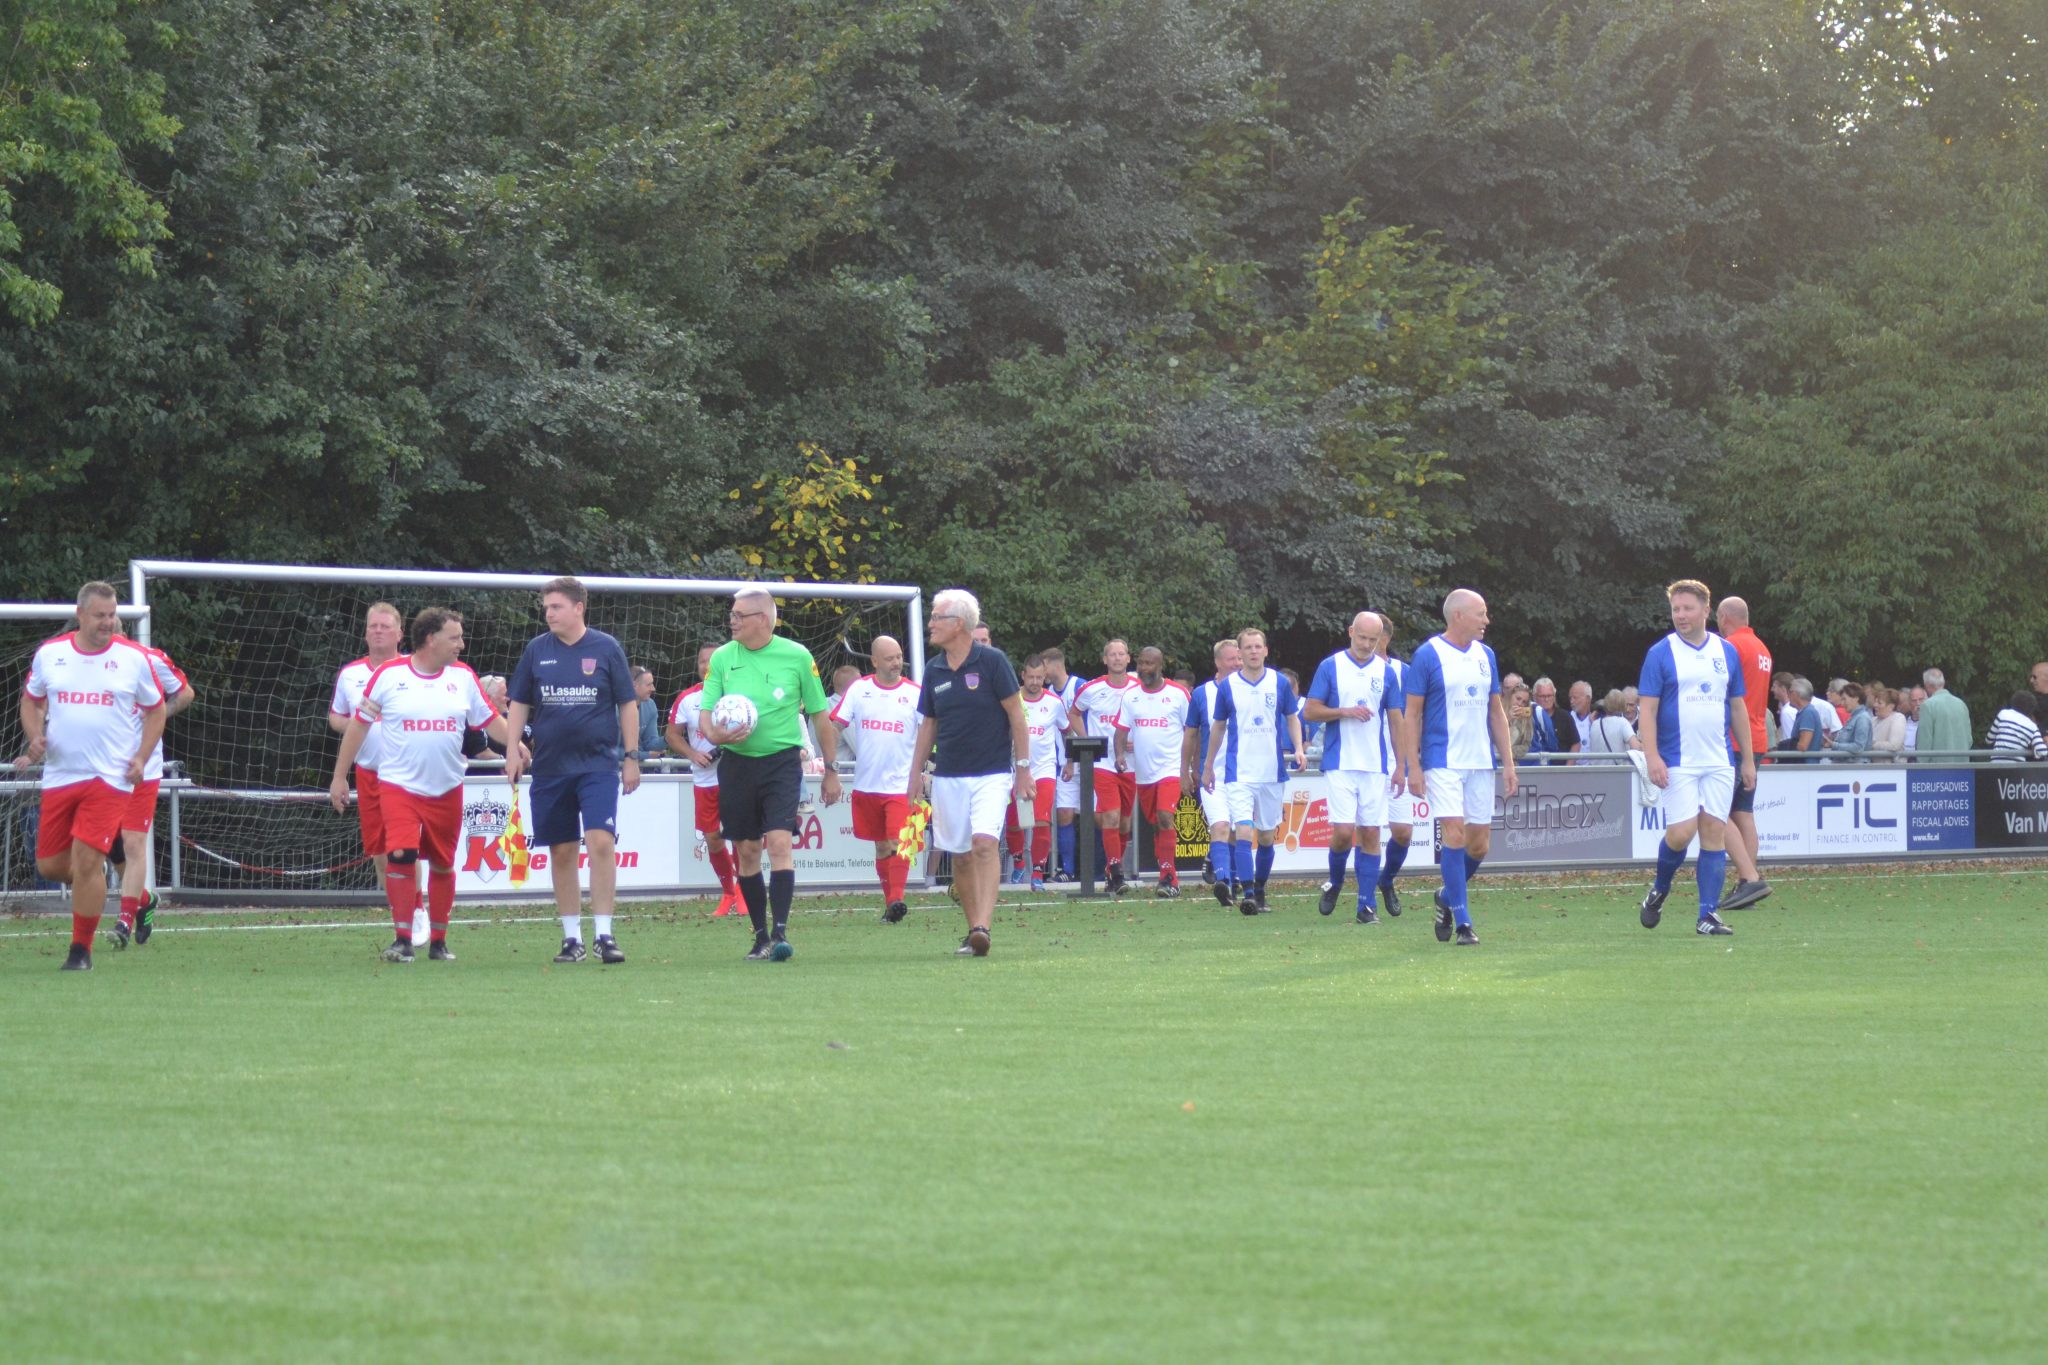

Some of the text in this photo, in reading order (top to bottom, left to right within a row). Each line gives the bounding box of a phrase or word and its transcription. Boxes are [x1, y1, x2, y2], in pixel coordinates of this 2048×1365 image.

[551, 685, 598, 696] Lasaulec
[1912, 782, 1969, 792] BEDRIJFSADVIES
[1912, 799, 1969, 810] RAPPORTAGES
[1912, 816, 1969, 827] FISCAAL ADVIES
[2005, 812, 2034, 833] Van
[1816, 833, 1898, 844] FINANCE IN CONTROL
[848, 858, 874, 868] Telefoon
